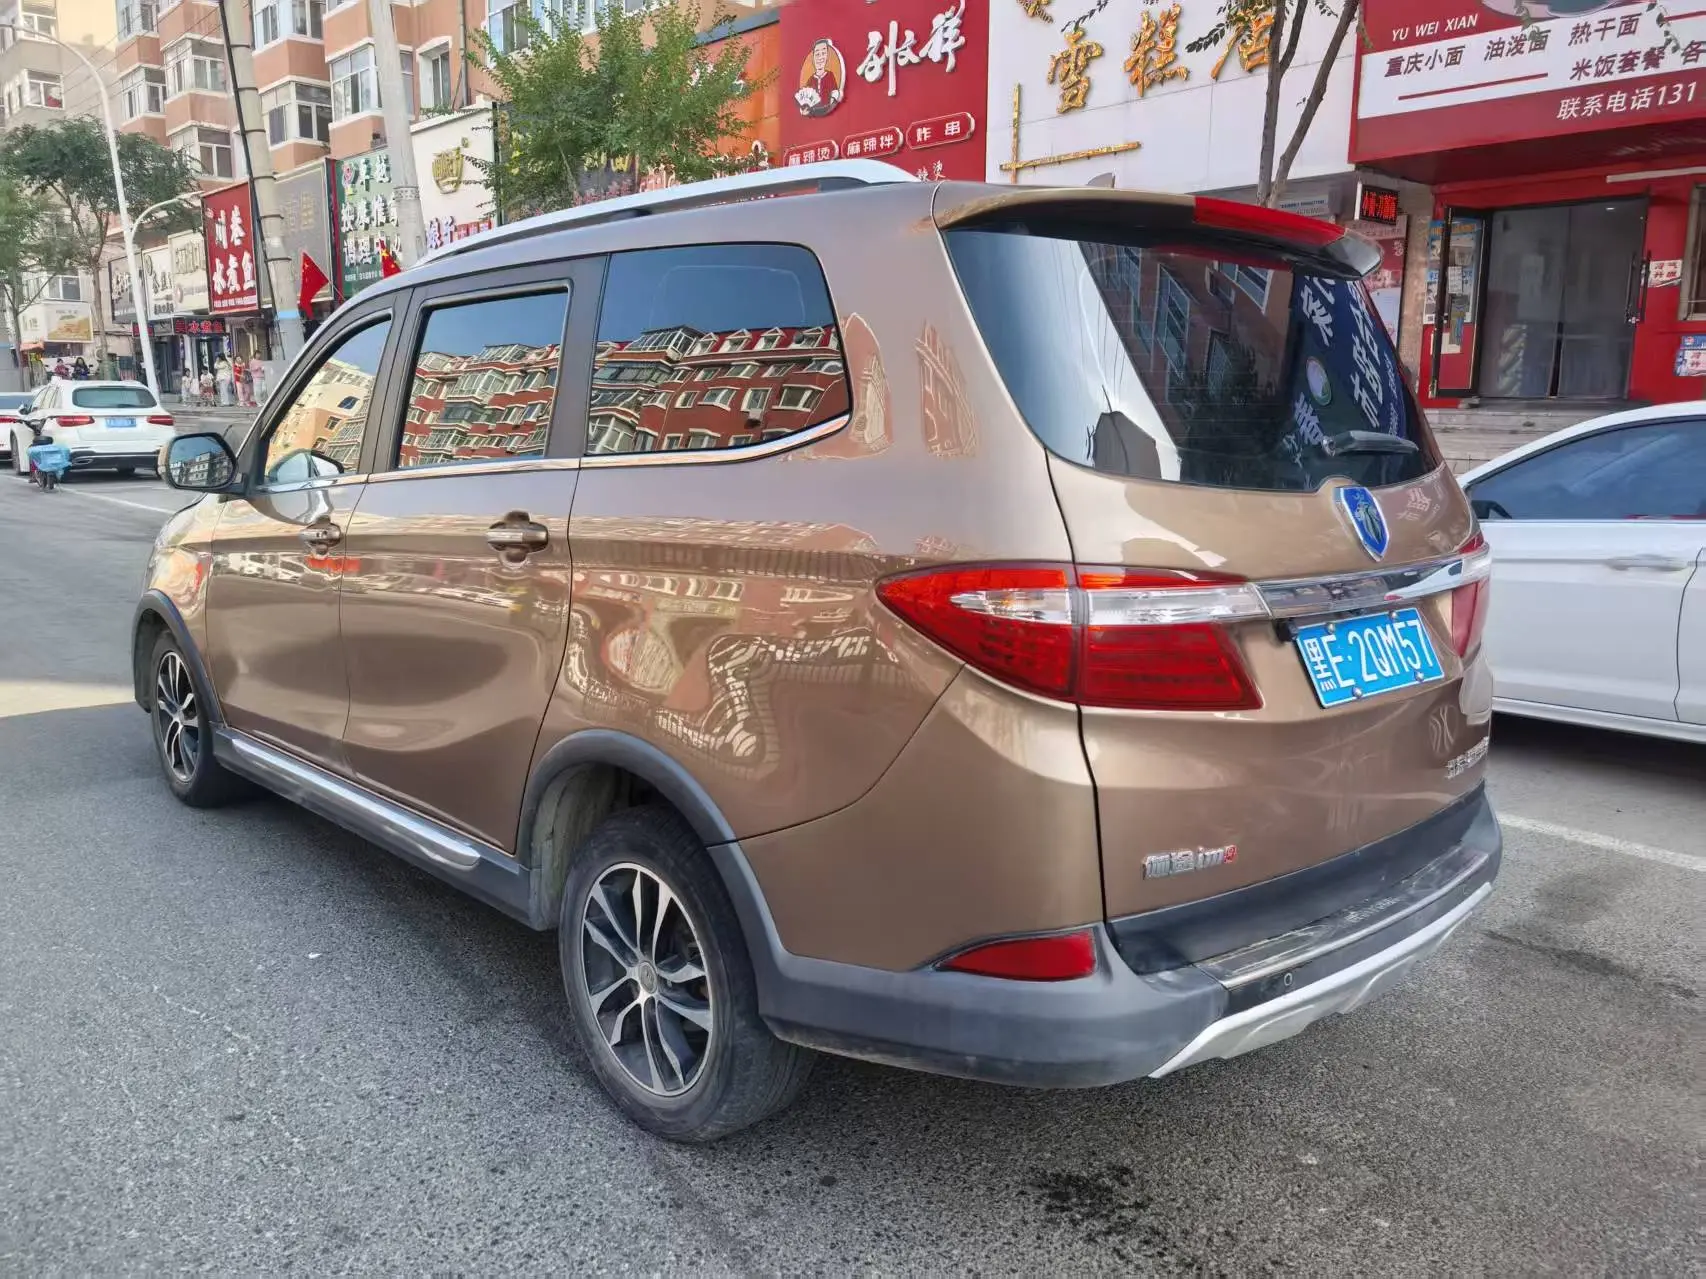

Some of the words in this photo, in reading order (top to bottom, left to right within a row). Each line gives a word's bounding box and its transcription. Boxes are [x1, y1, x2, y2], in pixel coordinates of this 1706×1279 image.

[1392, 28, 1409, 41] YU
[1415, 21, 1439, 37] WEI
[1445, 13, 1478, 32] XIAN
[1384, 45, 1465, 77] 重庆小面
[1484, 29, 1551, 61] 油泼面
[1568, 12, 1642, 46] 热干面
[1570, 46, 1665, 80] 米饭套餐
[1557, 81, 1697, 120] 联系电话131
[788, 147, 831, 166] 麻辣烫
[847, 135, 894, 155] 麻辣拌
[1304, 620, 1433, 691] 黑E·2QM57
